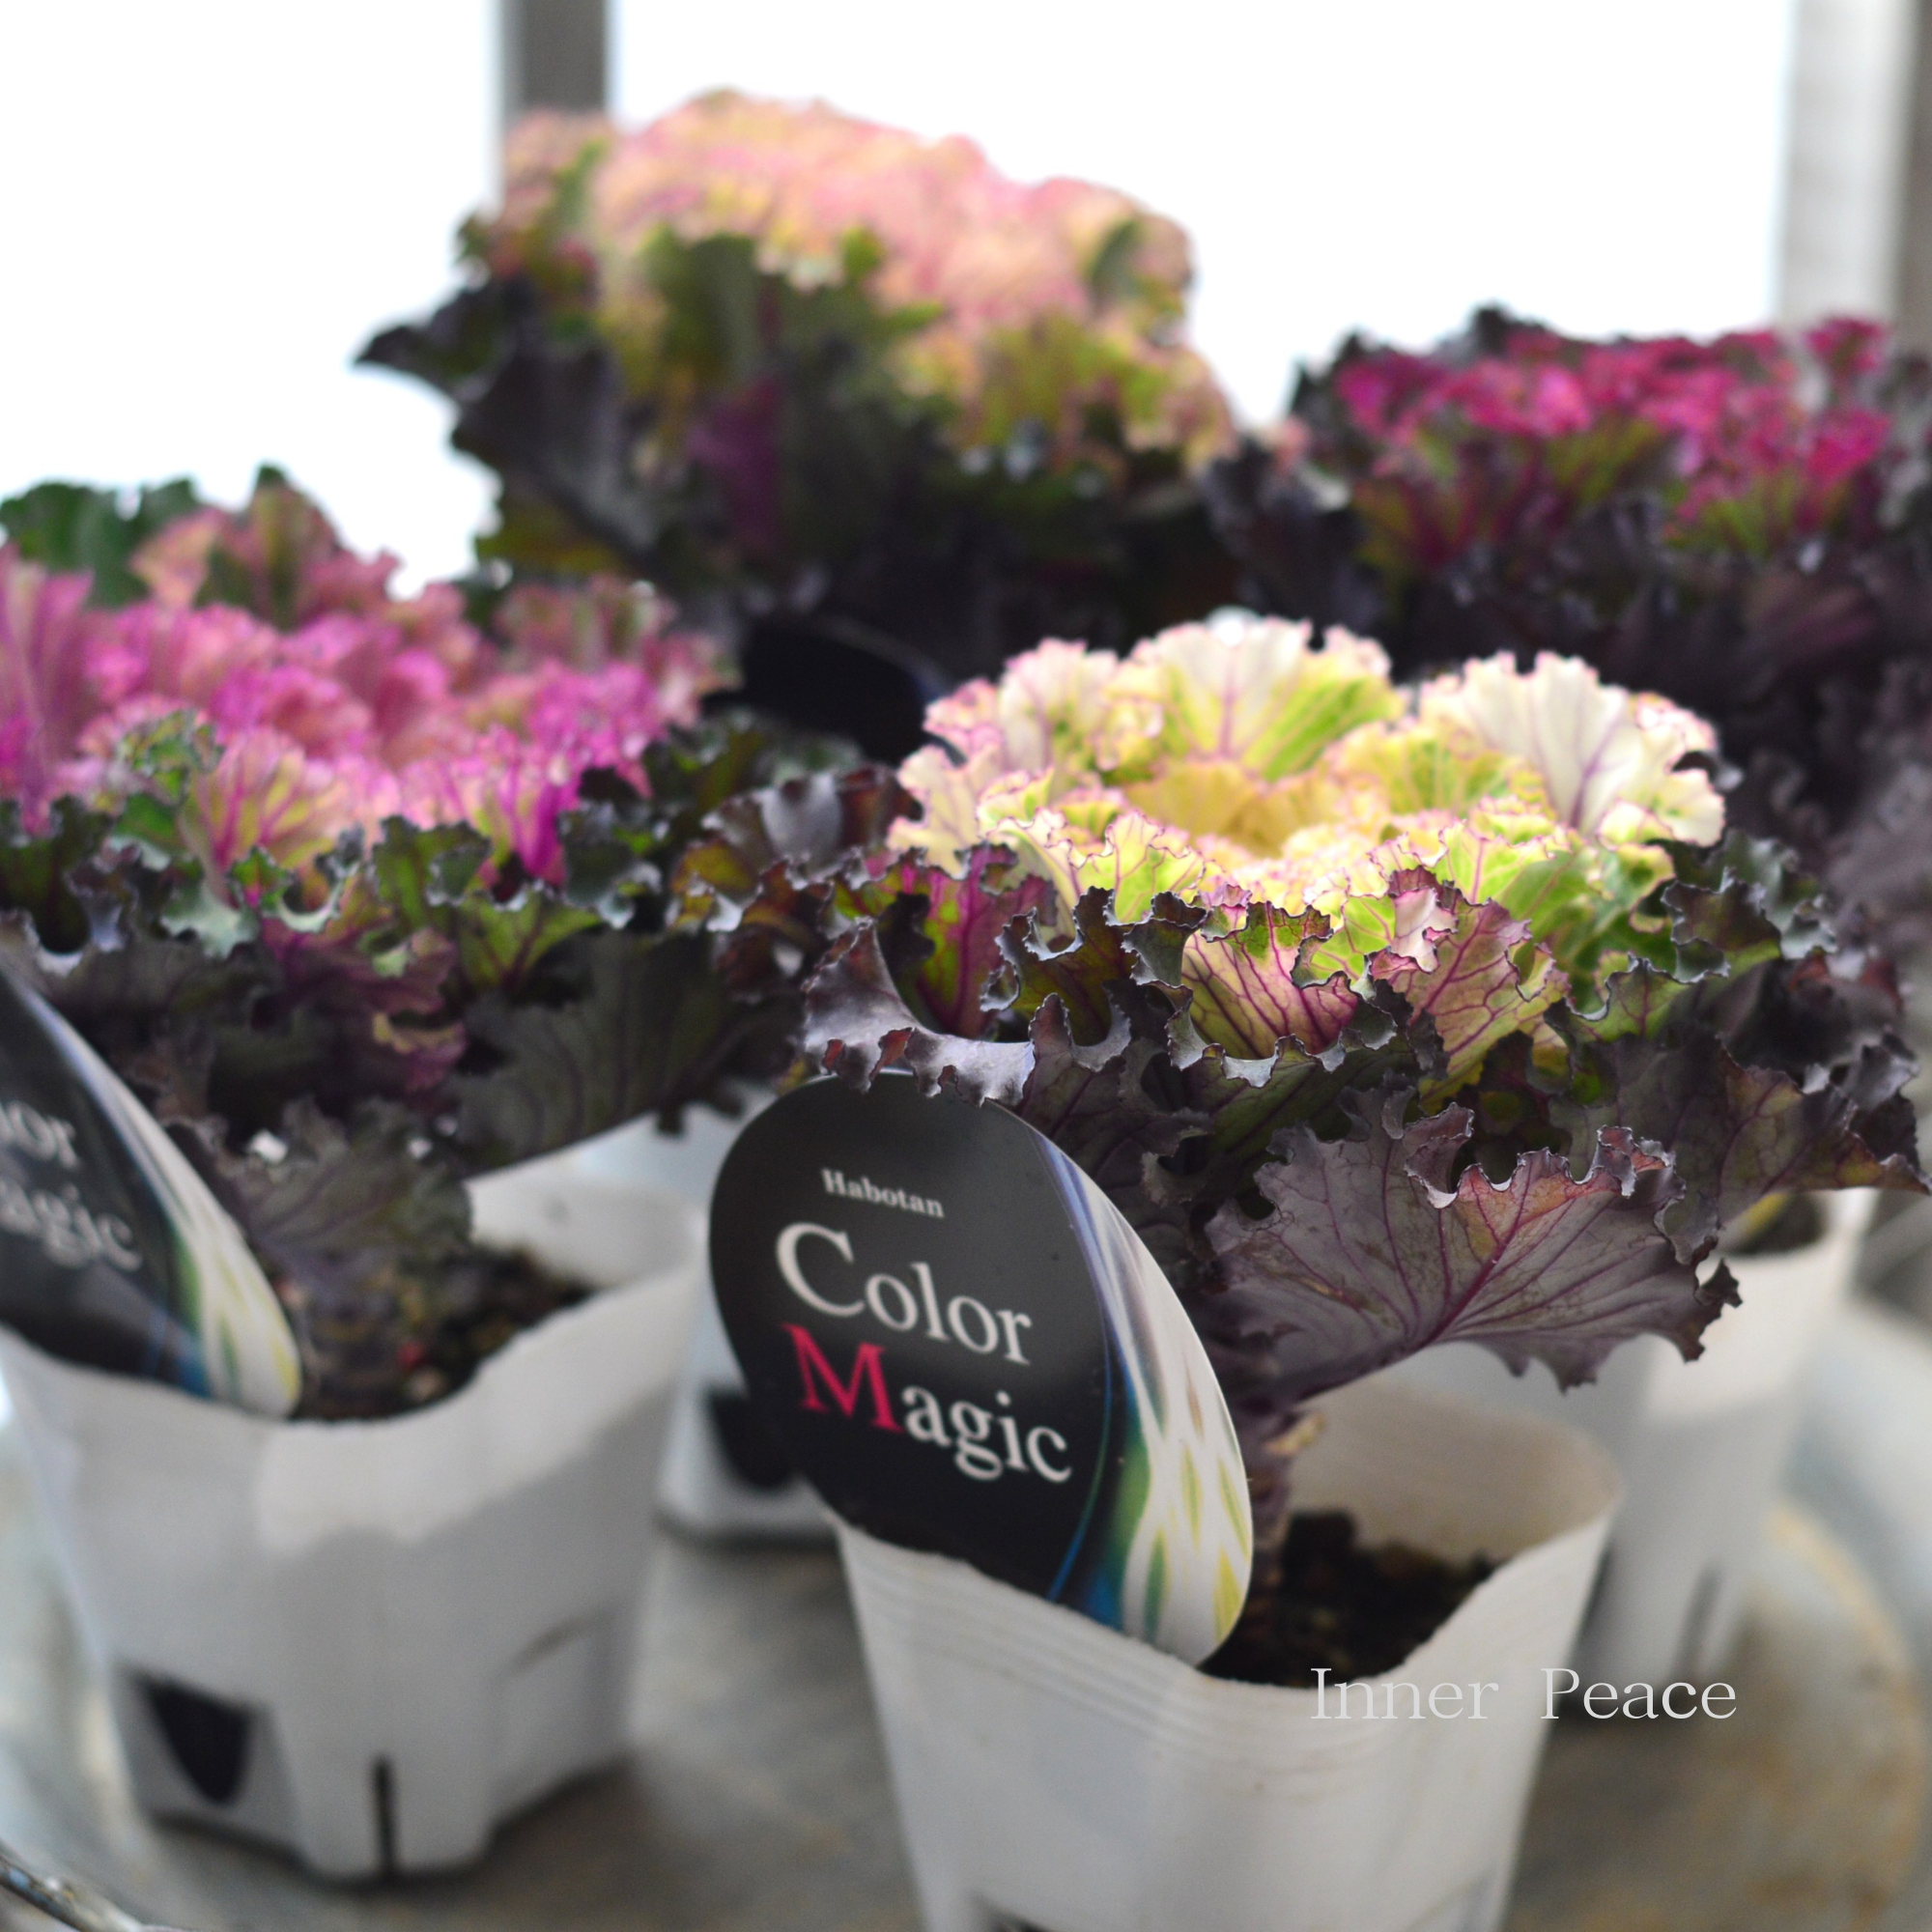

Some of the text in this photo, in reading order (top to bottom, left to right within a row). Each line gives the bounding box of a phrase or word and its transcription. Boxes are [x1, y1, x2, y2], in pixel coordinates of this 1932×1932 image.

[821, 1169, 945, 1218] Habotan
[777, 1222, 1032, 1365] Color
[782, 1323, 1072, 1483] Magic
